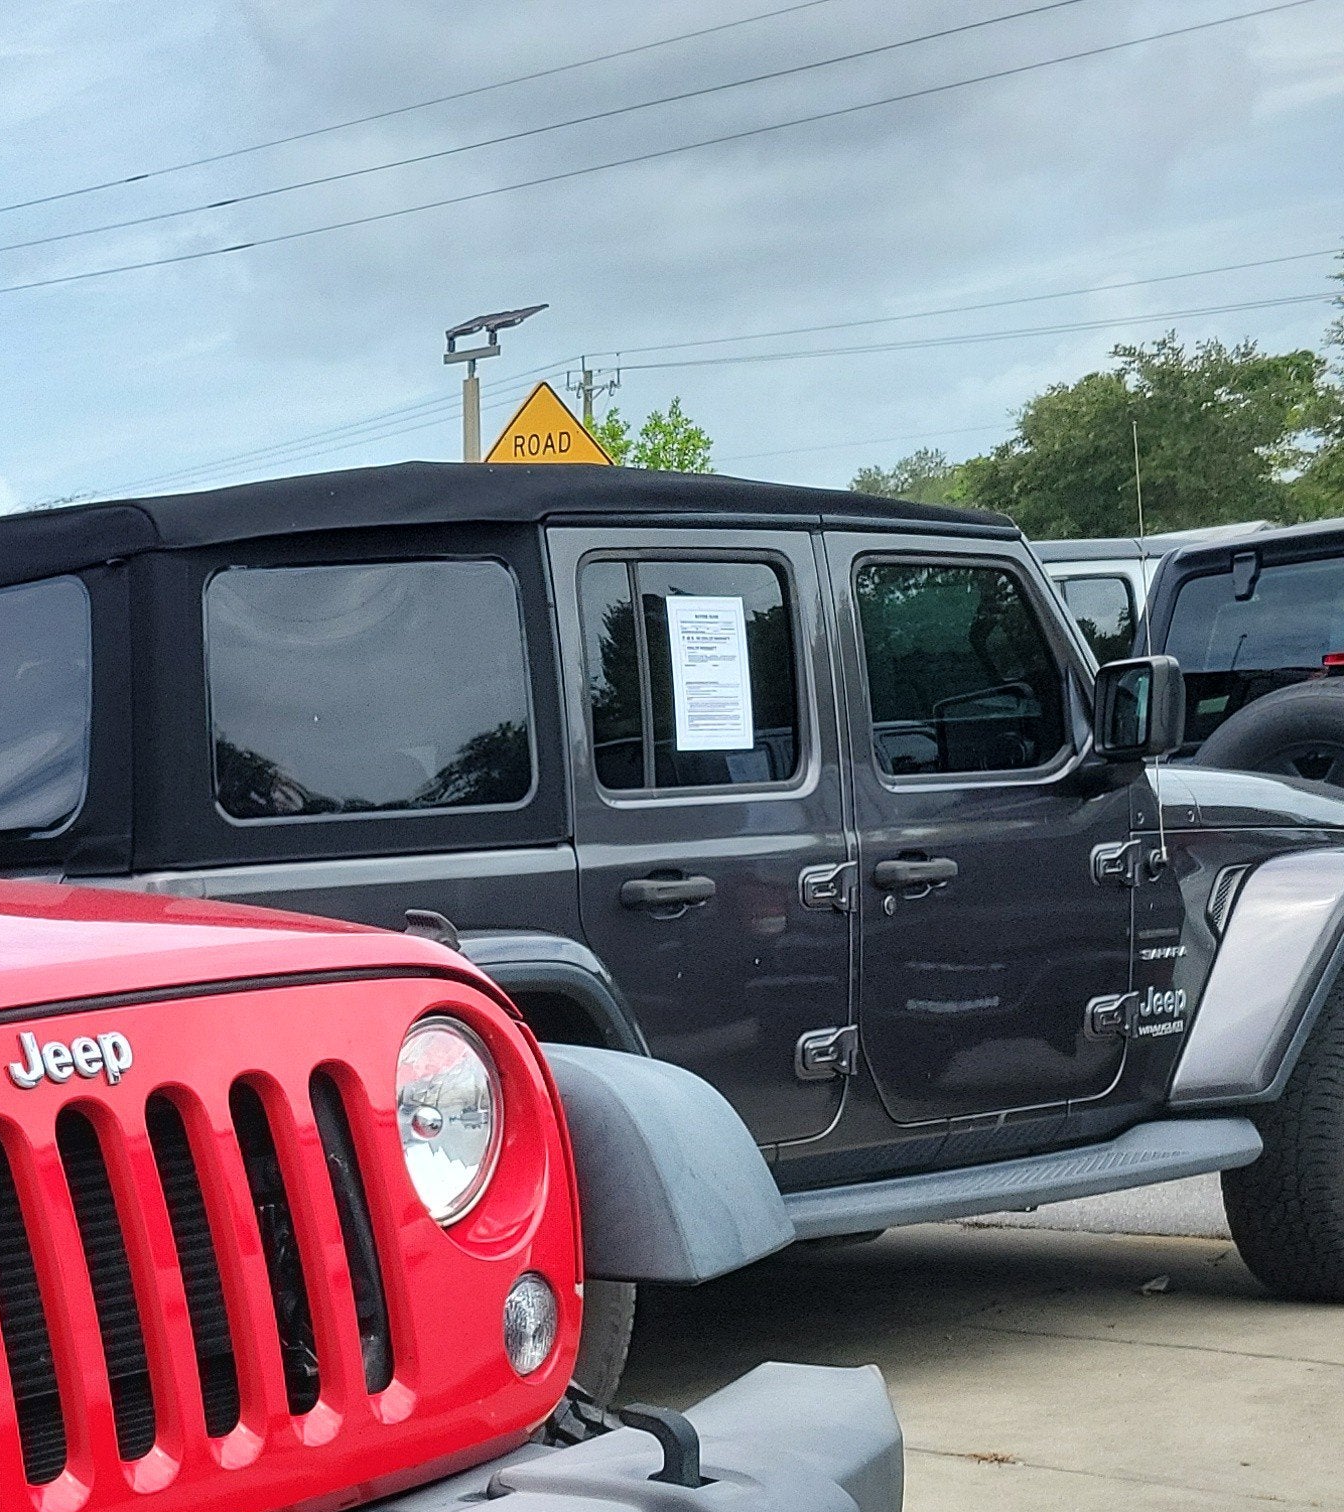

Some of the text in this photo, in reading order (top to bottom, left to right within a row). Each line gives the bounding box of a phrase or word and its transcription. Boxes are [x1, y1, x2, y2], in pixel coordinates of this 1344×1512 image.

[513, 431, 571, 458] ROAD
[1140, 985, 1187, 1018] Jeep
[8, 1030, 133, 1089] Jeep
